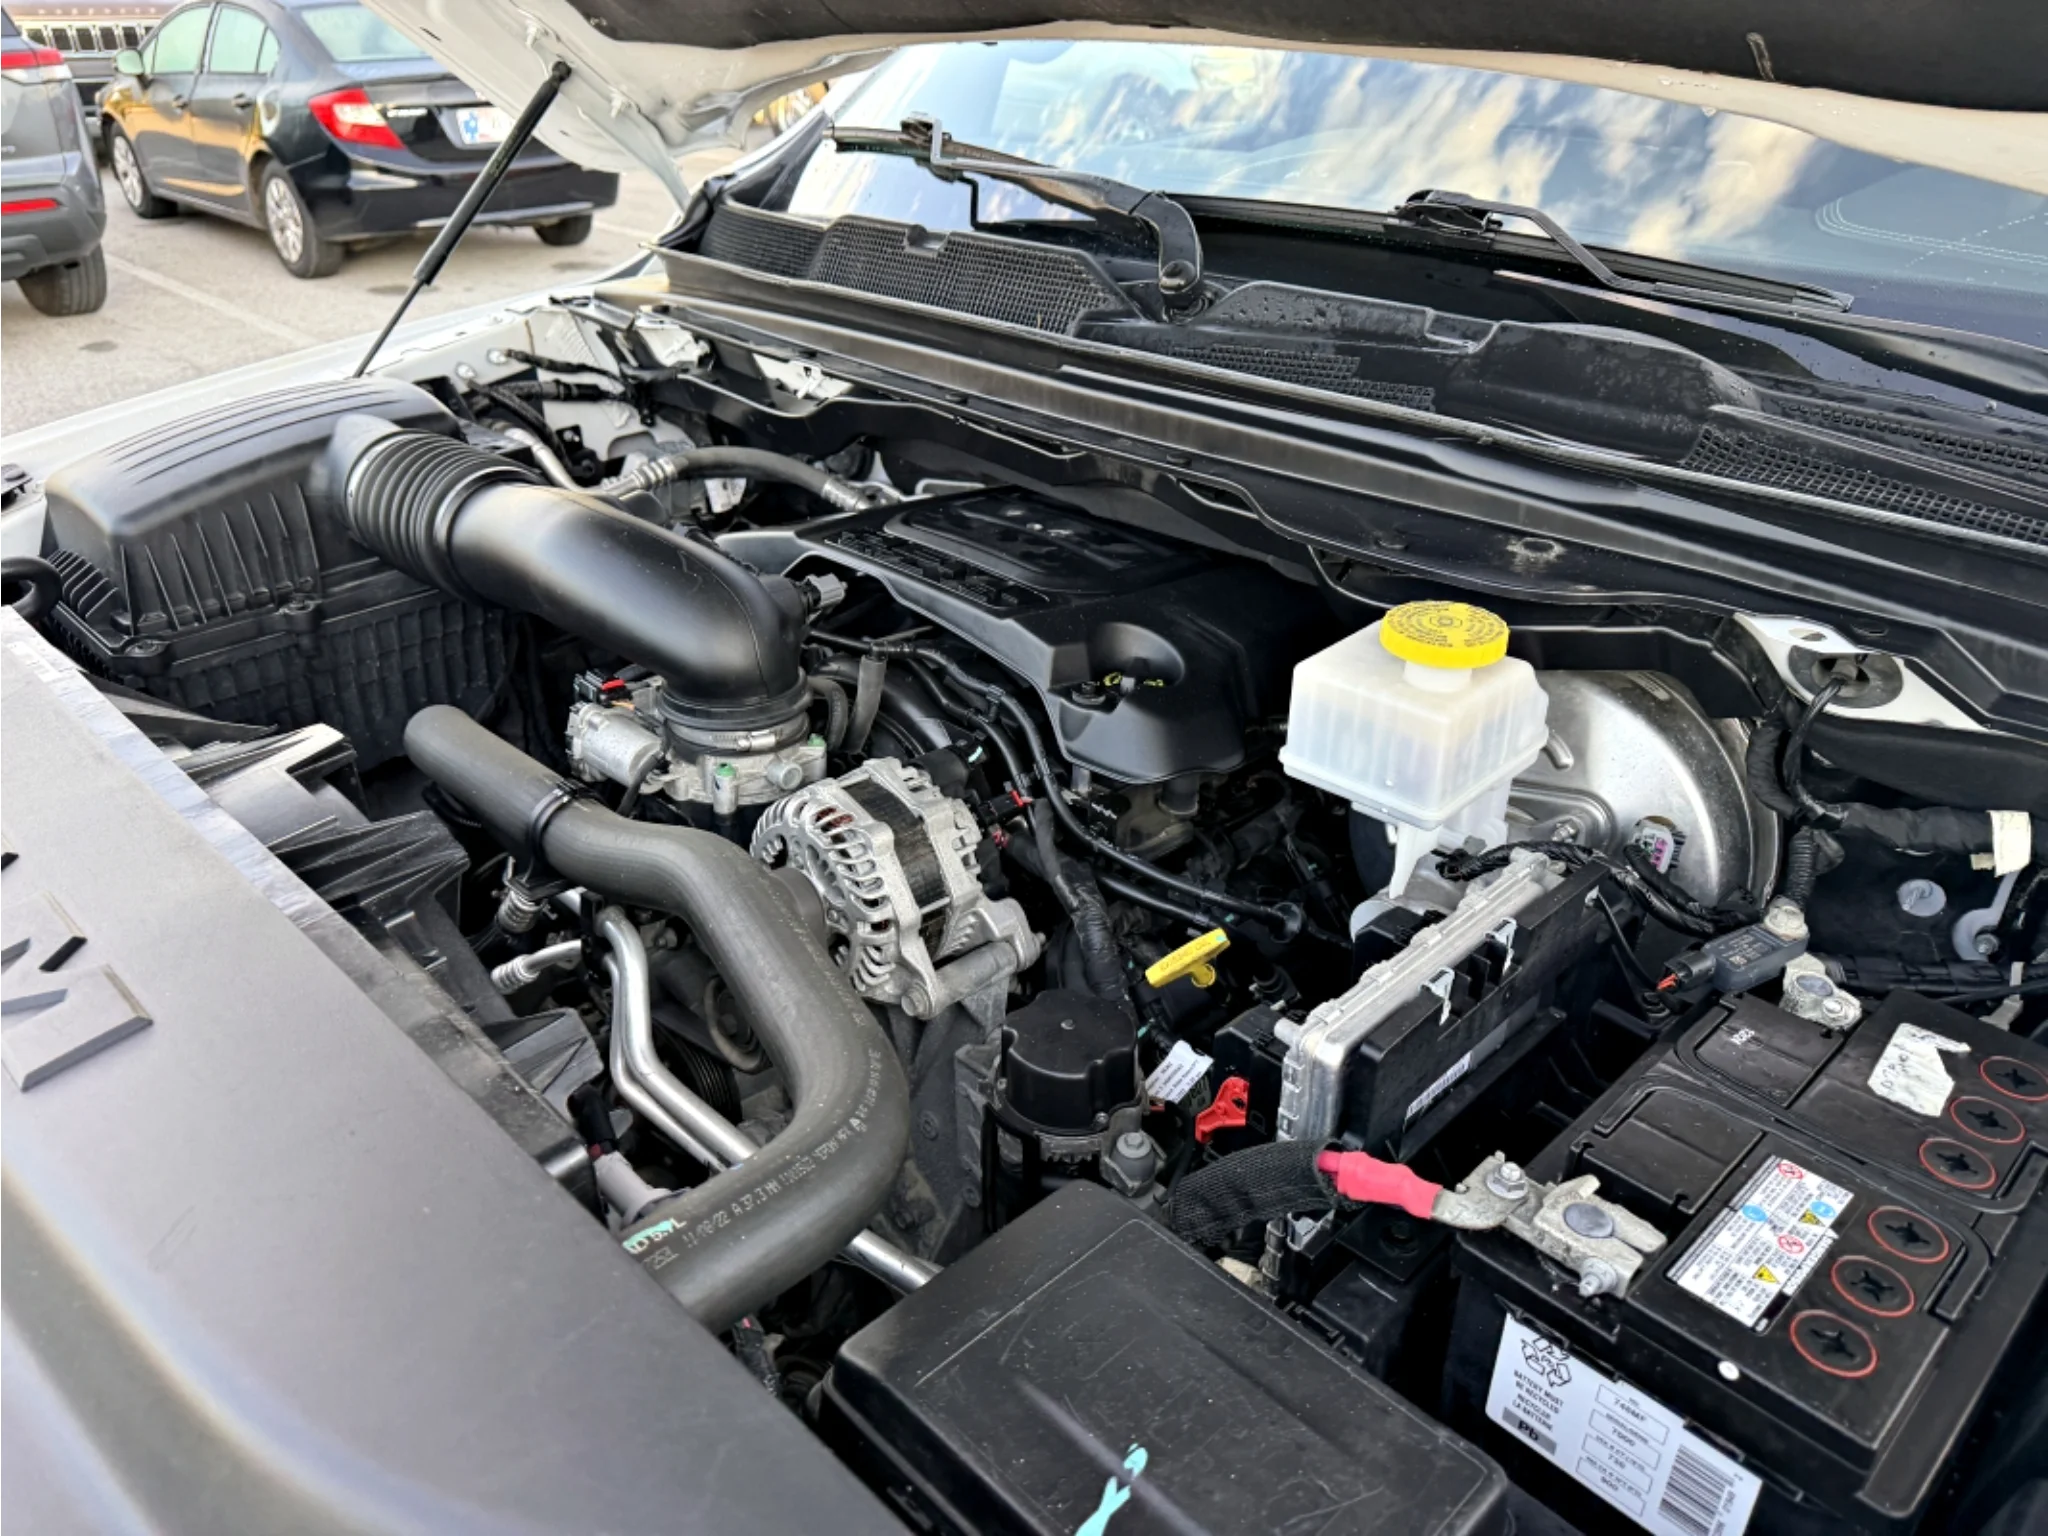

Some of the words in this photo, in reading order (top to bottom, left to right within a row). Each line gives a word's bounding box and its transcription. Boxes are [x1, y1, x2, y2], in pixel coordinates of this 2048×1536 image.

[1513, 1369, 1543, 1392] BATTERY
[1544, 1389, 1564, 1407] MUST
[1515, 1380, 1525, 1391] BE
[1525, 1387, 1559, 1414] RECYCLED
[1518, 1420, 1539, 1441] Pb
